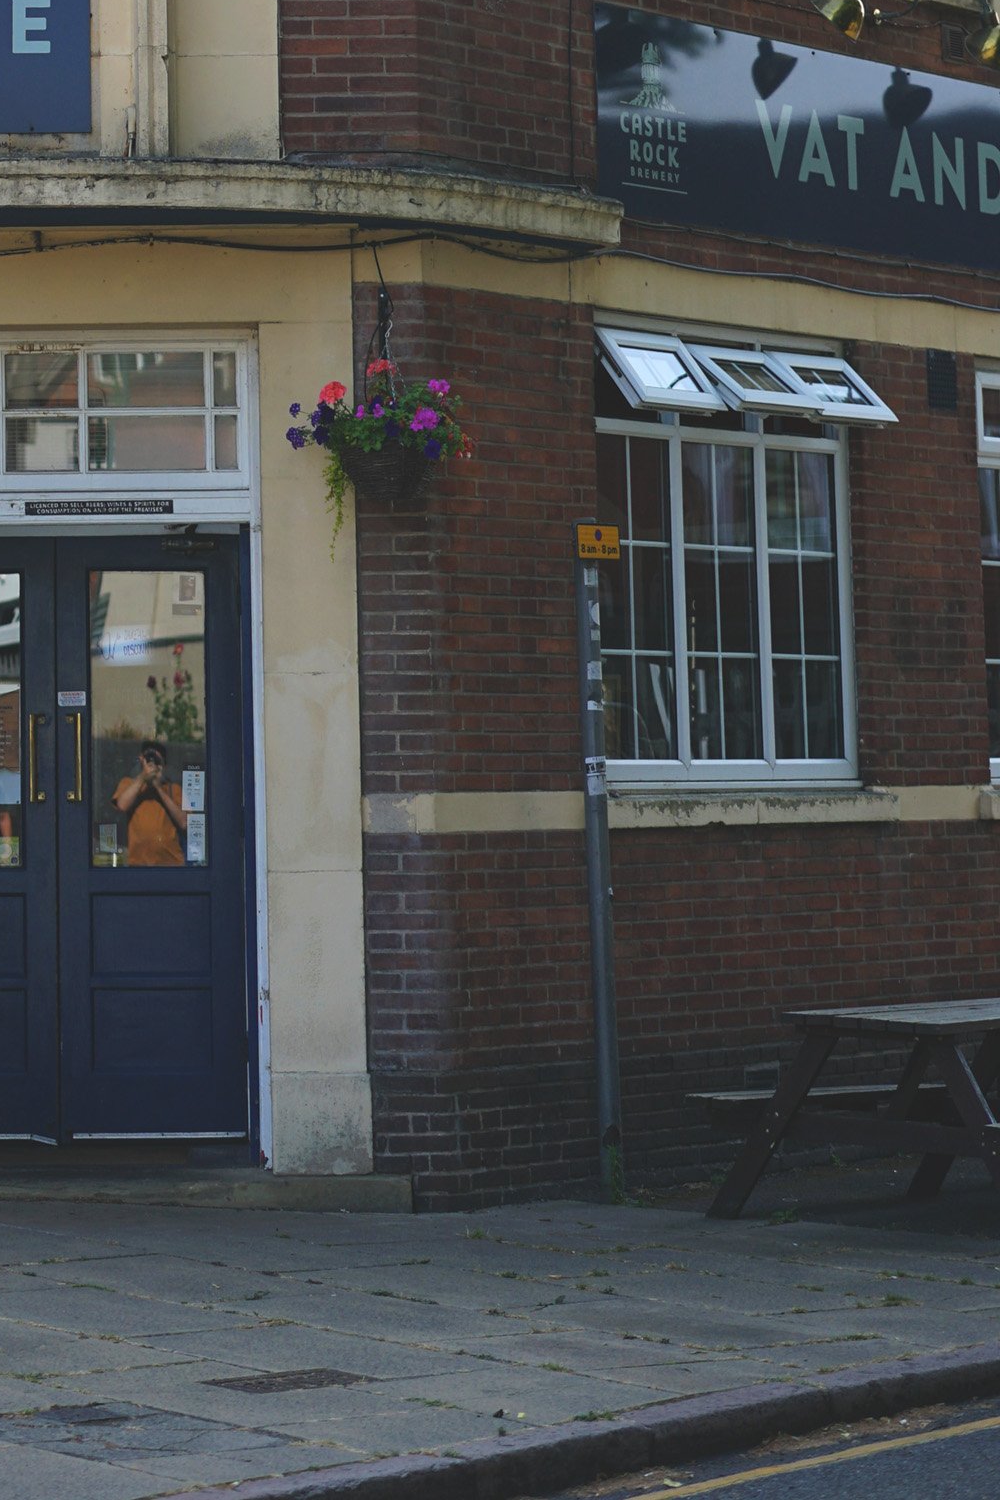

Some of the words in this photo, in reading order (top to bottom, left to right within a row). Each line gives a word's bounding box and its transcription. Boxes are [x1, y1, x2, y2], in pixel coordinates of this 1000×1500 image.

[620, 111, 687, 143] CASTLE
[630, 139, 680, 168] ROCK
[754, 98, 865, 191] VAT
[889, 125, 1000, 216] AND
[630, 166, 680, 183] BREWERY
